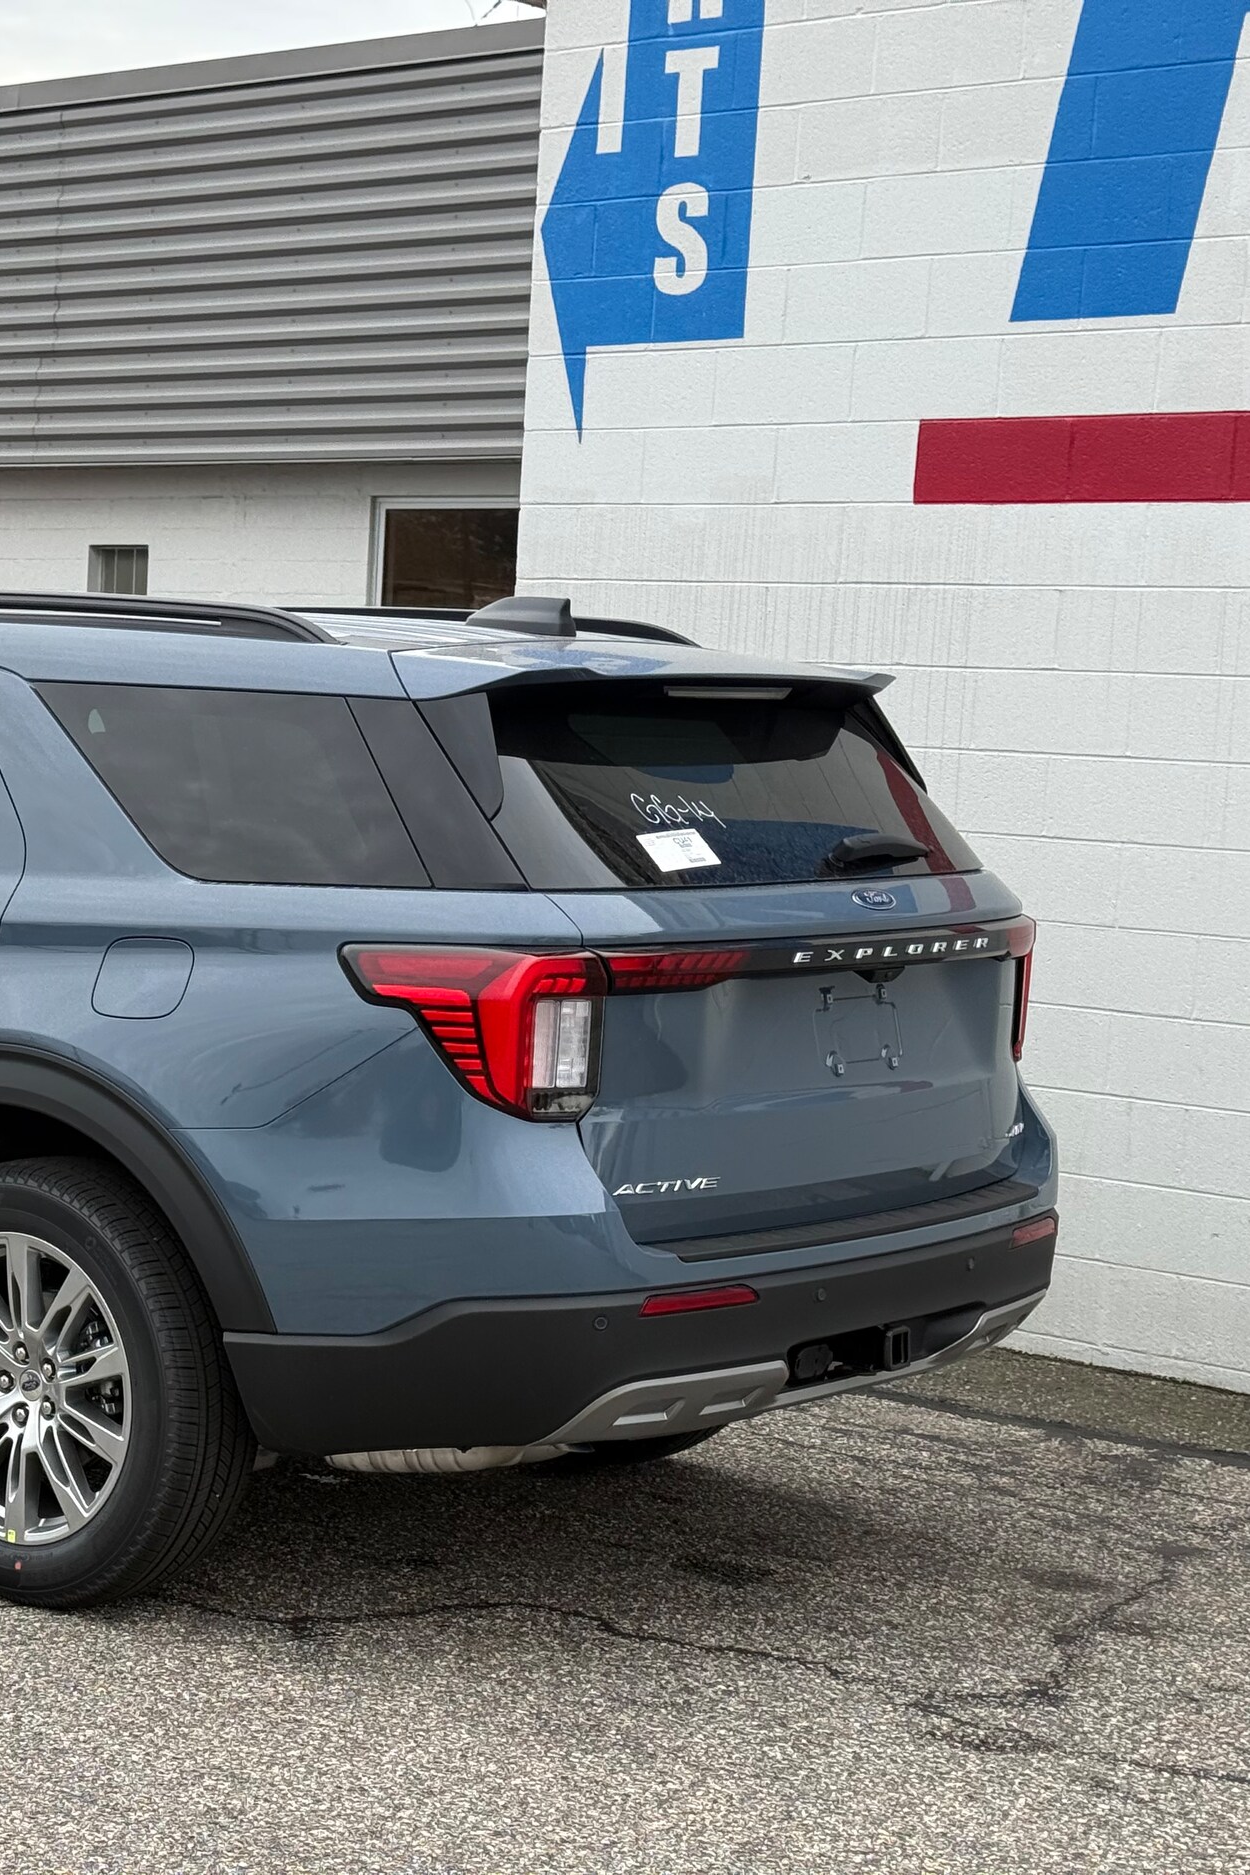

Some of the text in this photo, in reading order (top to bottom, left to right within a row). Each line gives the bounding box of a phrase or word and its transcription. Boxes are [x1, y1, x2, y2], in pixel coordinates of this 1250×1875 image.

[653, 0, 723, 296] TS
[792, 937, 990, 963] EXPLORER
[612, 1176, 721, 1196] ACTIVE
